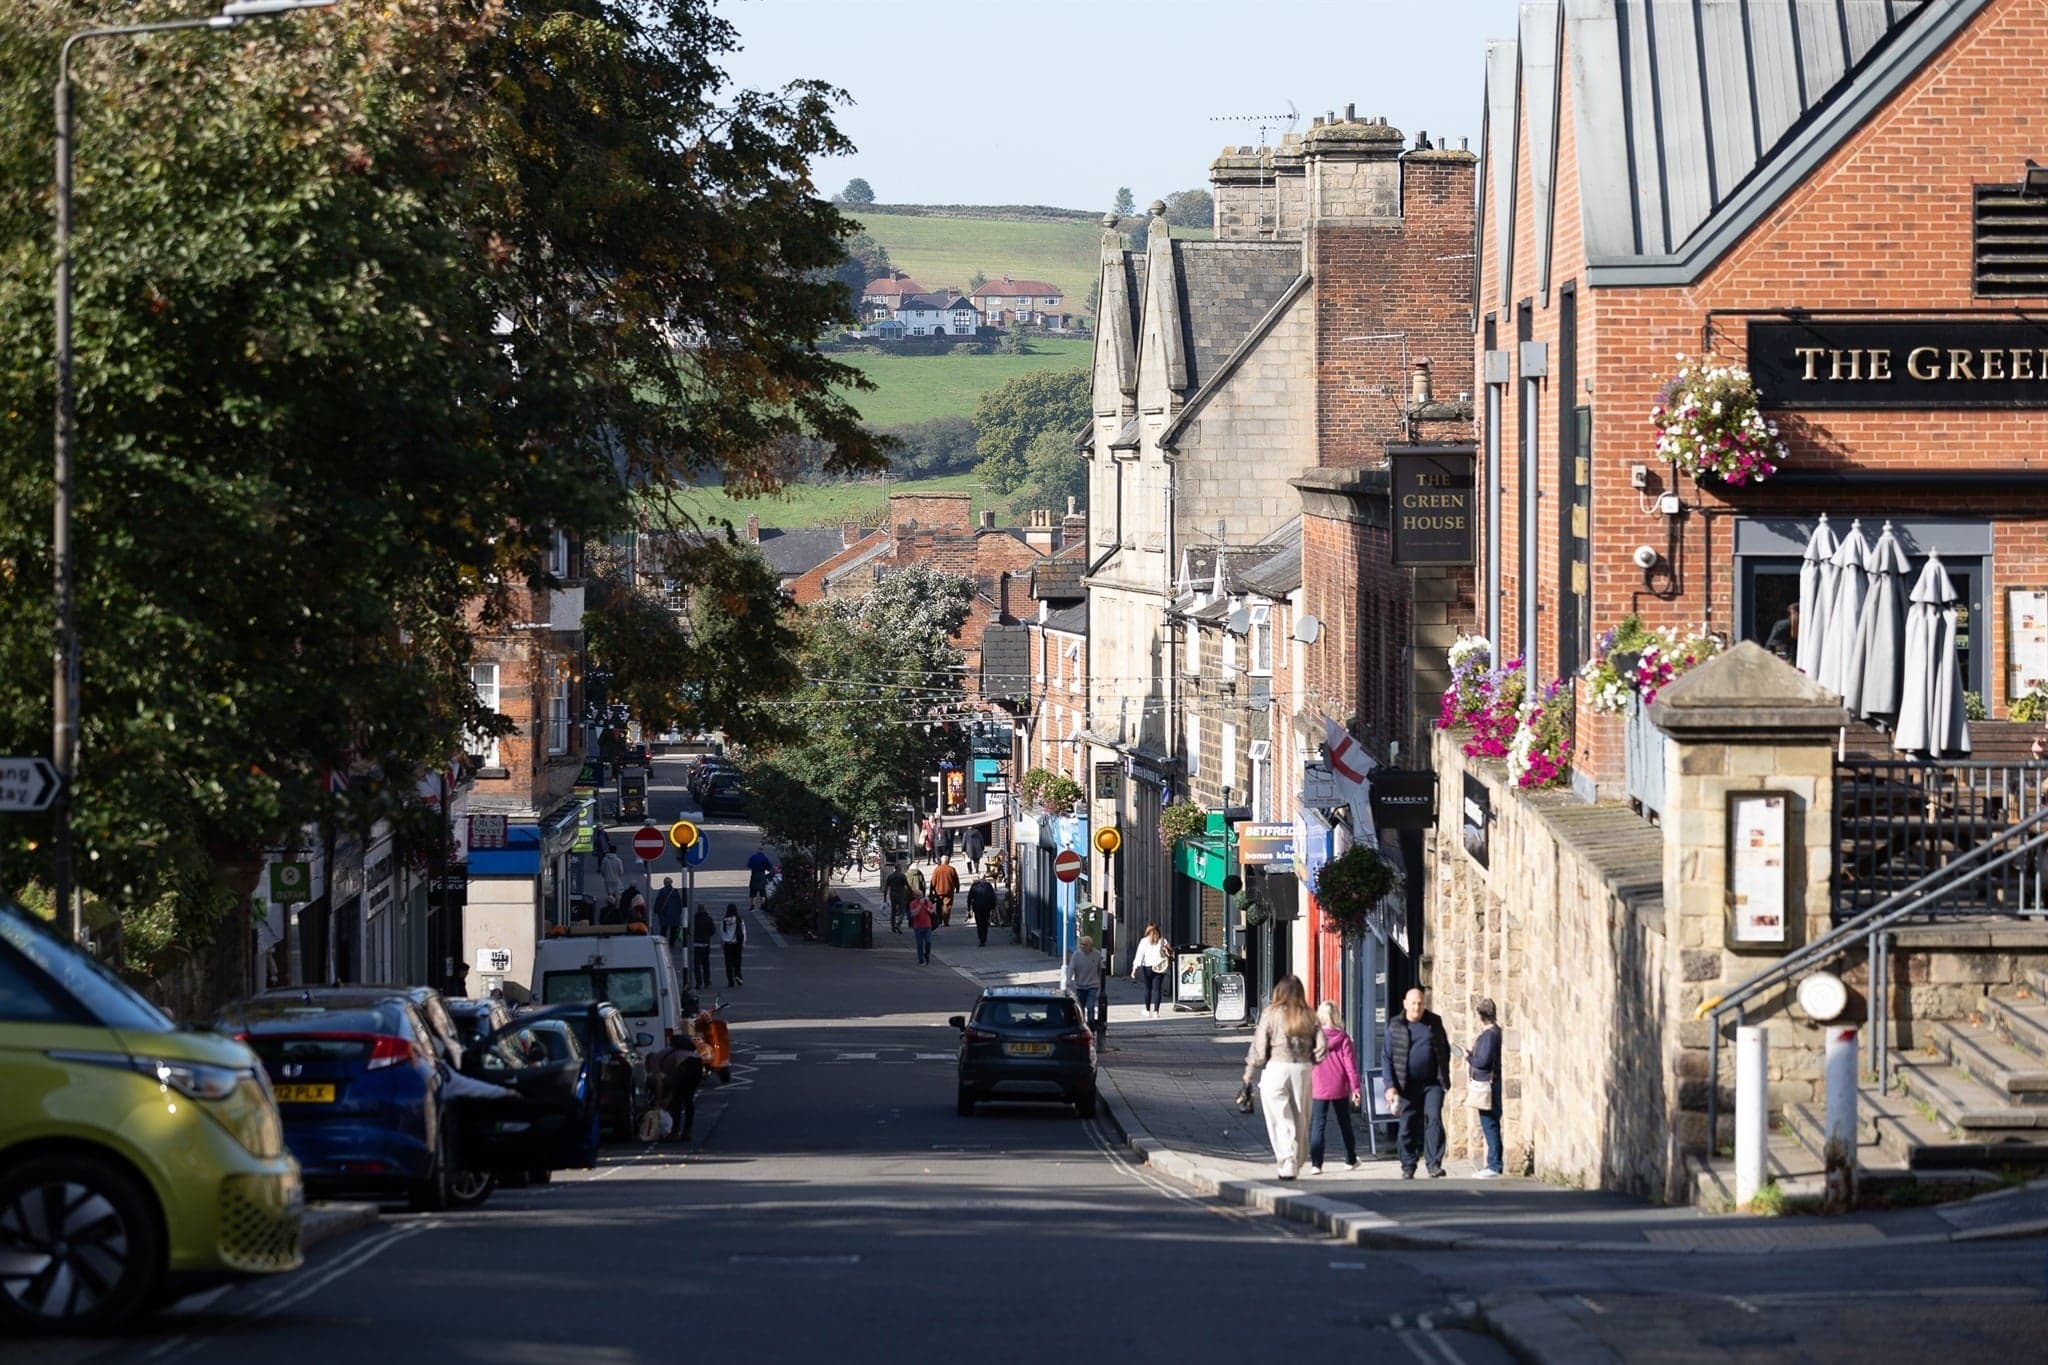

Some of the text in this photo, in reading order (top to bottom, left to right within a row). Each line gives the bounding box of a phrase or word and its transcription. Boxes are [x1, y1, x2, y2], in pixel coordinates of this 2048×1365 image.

[1795, 347, 1891, 381] THE
[1416, 473, 1451, 487] THE
[1402, 494, 1465, 508] GREEN
[1402, 516, 1465, 530] HOUSE
[1244, 851, 1274, 860] bonus
